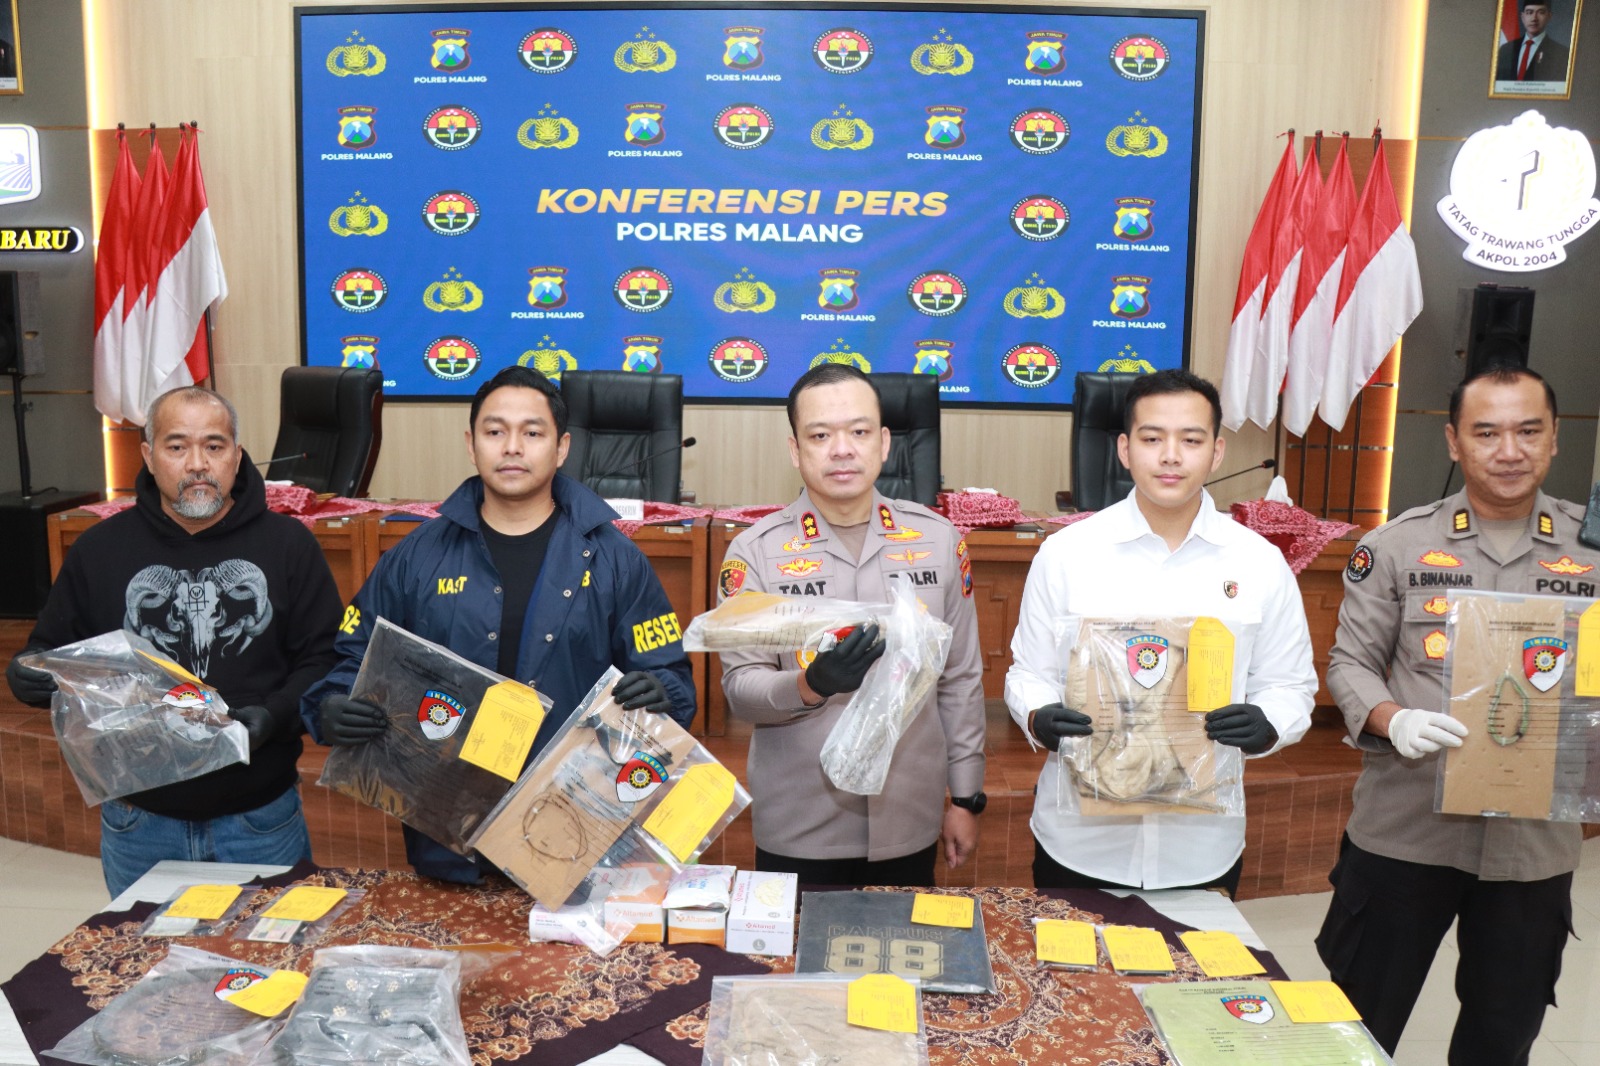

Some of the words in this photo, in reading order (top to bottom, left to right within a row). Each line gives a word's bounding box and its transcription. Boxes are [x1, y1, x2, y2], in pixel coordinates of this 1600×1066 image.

[742, 74, 782, 82] MALANG
[1007, 78, 1042, 86] POLRES
[1043, 79, 1083, 87] MALANG
[321, 153, 354, 161] POLRES
[355, 152, 393, 160] MALANG
[907, 152, 942, 160] POLRES
[943, 153, 983, 161] MALANG
[537, 188, 820, 214] KONFERENSI
[835, 191, 949, 216] PERS
[1447, 202, 1479, 236] TATAG
[1480, 231, 1545, 251] TRAWANG
[1547, 207, 1598, 247] TUNGGA
[617, 222, 727, 242] POLRES
[736, 223, 864, 243] MALANG
[1096, 243, 1130, 251] POLRES
[1131, 244, 1170, 252] MALANG
[1476, 249, 1520, 267] AKPOL
[1524, 251, 1557, 267] 2004
[800, 313, 835, 321] POLRES
[836, 314, 876, 322] MALANG
[1093, 320, 1126, 328] POLRES
[1128, 321, 1166, 329] MALANG
[1536, 578, 1595, 597] POLRI
[824, 936, 944, 980] 88
